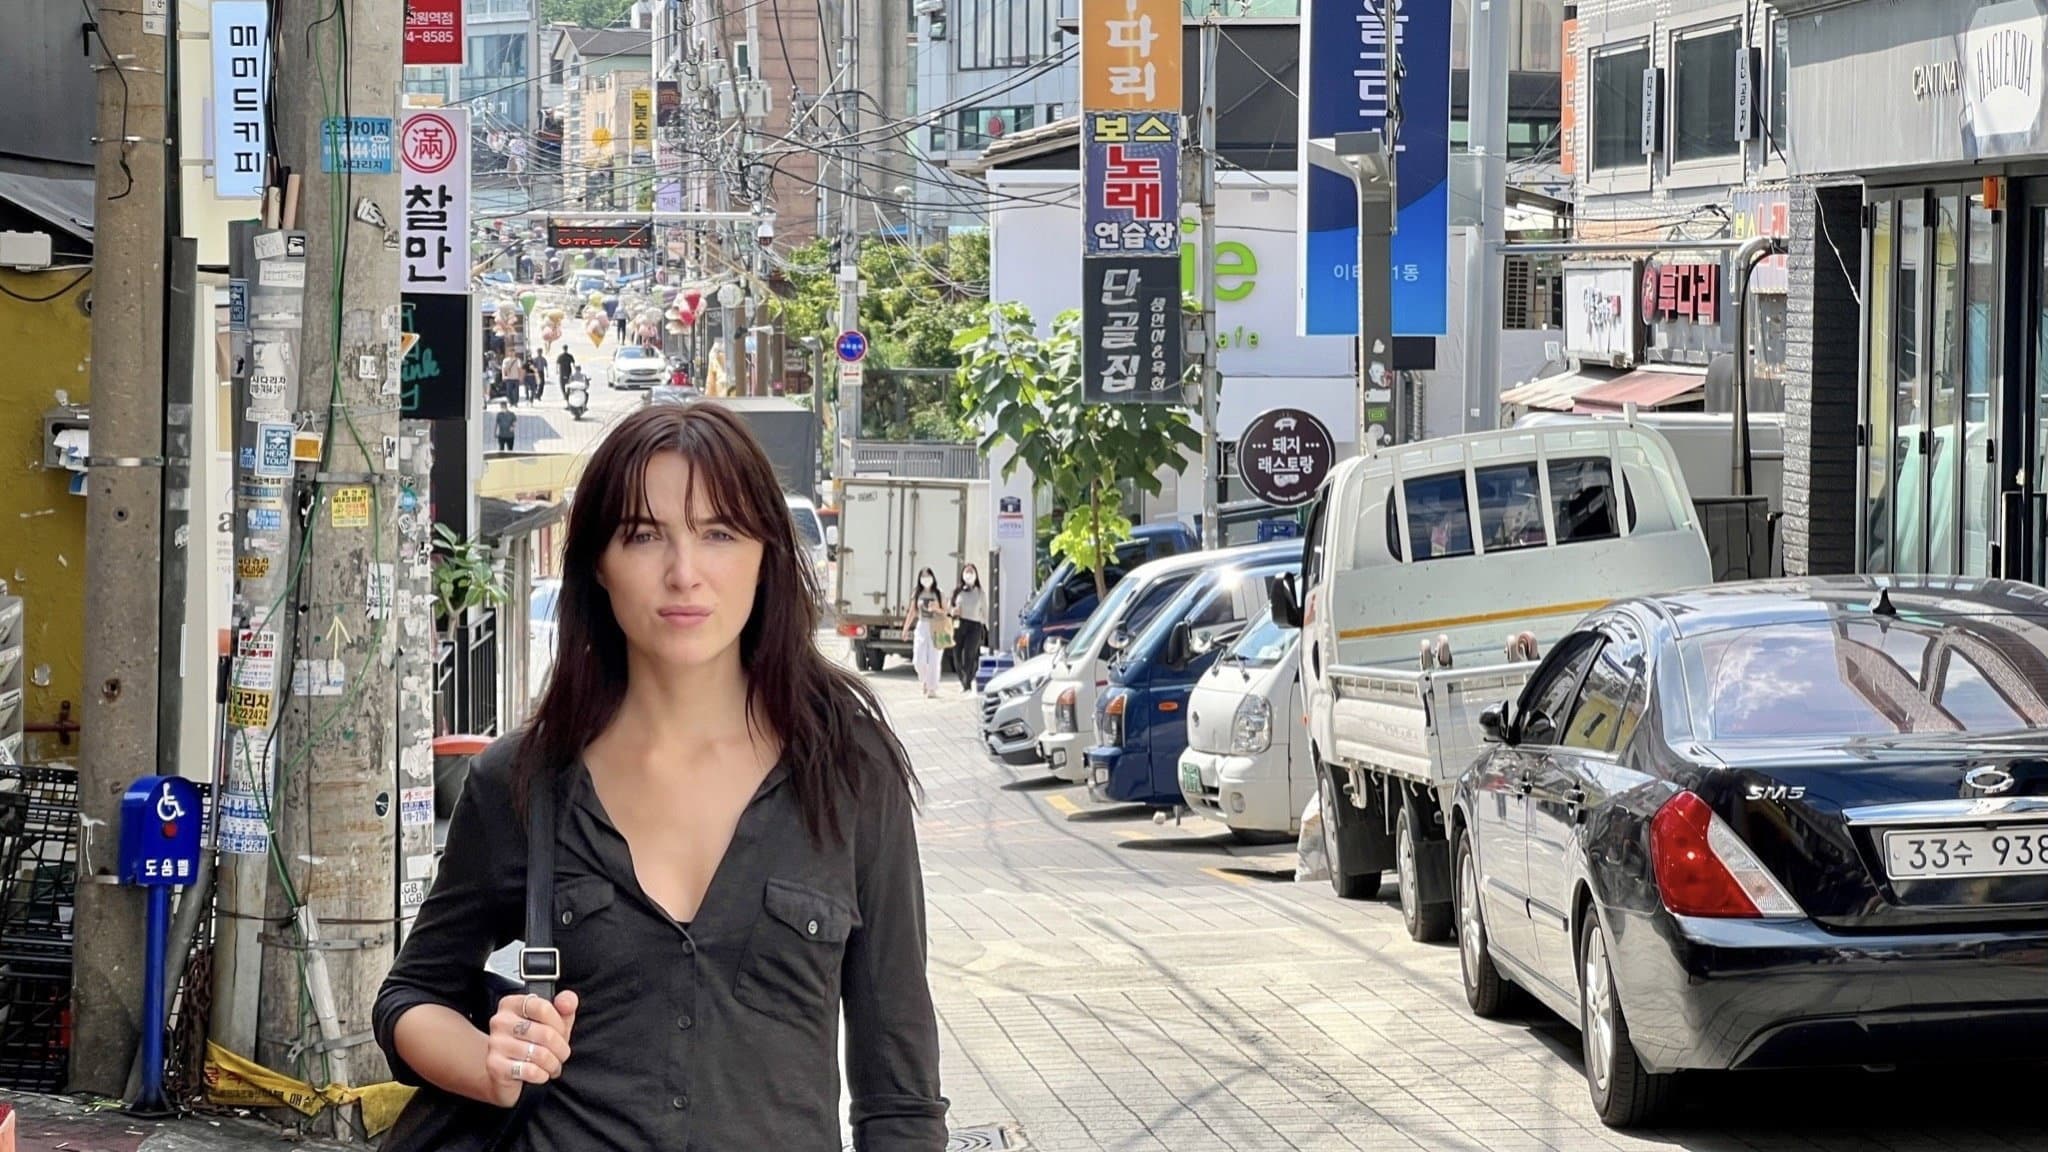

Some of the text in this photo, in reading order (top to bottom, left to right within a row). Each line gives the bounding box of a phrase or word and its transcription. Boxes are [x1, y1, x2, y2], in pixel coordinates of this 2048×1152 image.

[1107, 0, 1159, 102] 다리
[1976, 29, 2034, 103] HACIENDA
[1912, 60, 1960, 99] CANTINA
[229, 26, 261, 173] 매머드커피
[412, 128, 443, 160] 滿
[1095, 115, 1172, 142] 보스
[1104, 144, 1162, 220] 노래
[405, 184, 453, 282] 찰만
[1095, 222, 1175, 249] 연습장
[1100, 268, 1143, 393] 단골집
[265, 457, 288, 465] TOUR
[266, 442, 288, 451] LOCAL
[1272, 435, 1300, 455] 돼지
[1257, 455, 1314, 475] 래스토랑
[1745, 784, 1806, 800] SM5
[1908, 833, 2048, 870] 33수 938
